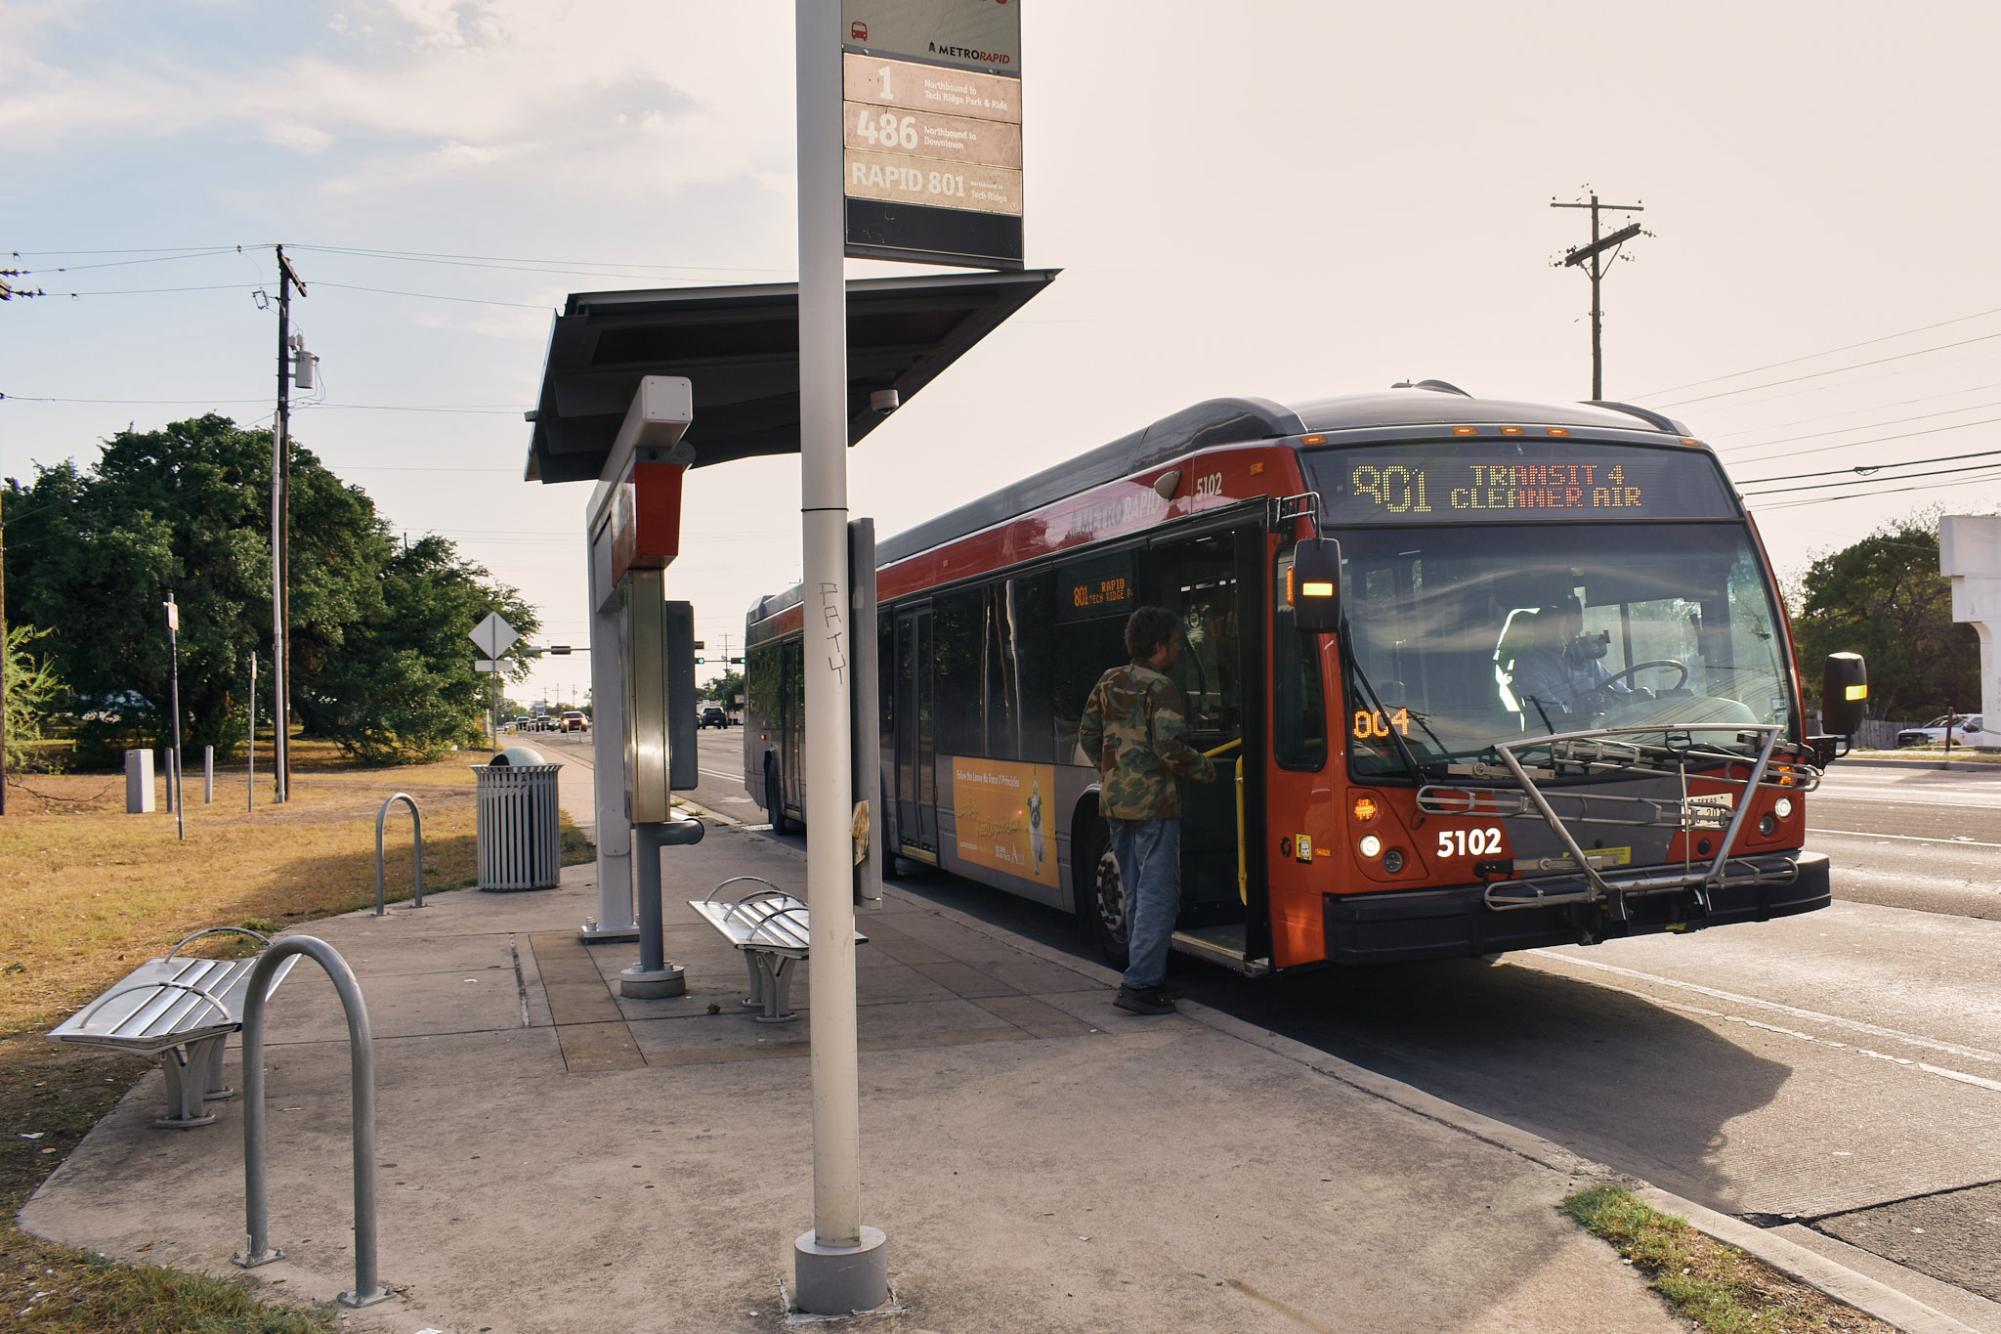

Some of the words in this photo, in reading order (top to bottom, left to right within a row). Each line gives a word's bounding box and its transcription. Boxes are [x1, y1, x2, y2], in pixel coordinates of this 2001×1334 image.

[939, 45, 1010, 64] METRORAPID
[878, 66, 896, 100] 1
[924, 80, 968, 94] Northbound
[969, 86, 977, 96] to
[924, 91, 942, 101] Tech
[943, 93, 964, 105] Ridge
[965, 96, 983, 107] Park
[857, 110, 919, 150] 486
[924, 126, 968, 140] Northbound
[969, 132, 977, 142] to
[852, 162, 923, 192] RAPID
[928, 171, 965, 197] 801
[1197, 472, 1223, 499] 5102
[1469, 464, 1598, 486] TRANSIT
[1607, 464, 1625, 486] 4
[1450, 487, 1584, 509] CLEANER
[1592, 486, 1642, 508] AIR
[1074, 583, 1089, 607] 801
[1100, 577, 1125, 593] RAPID
[1437, 827, 1502, 858] 5102
